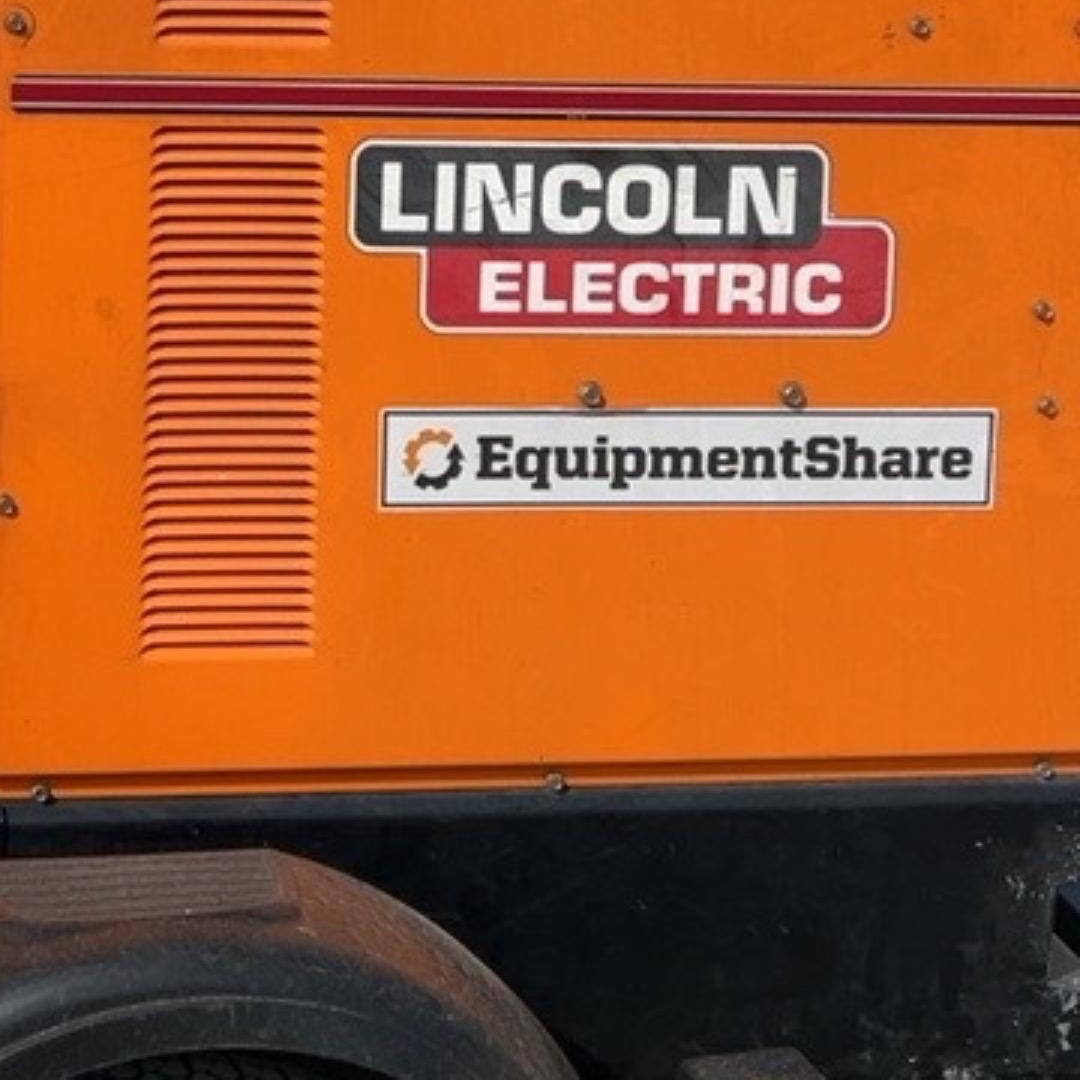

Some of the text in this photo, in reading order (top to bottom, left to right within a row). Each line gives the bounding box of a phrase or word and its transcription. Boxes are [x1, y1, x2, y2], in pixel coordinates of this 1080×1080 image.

[378, 161, 799, 236] LINCOLN
[478, 260, 842, 316] ELECTRIC
[476, 435, 973, 489] EquipmentShare
